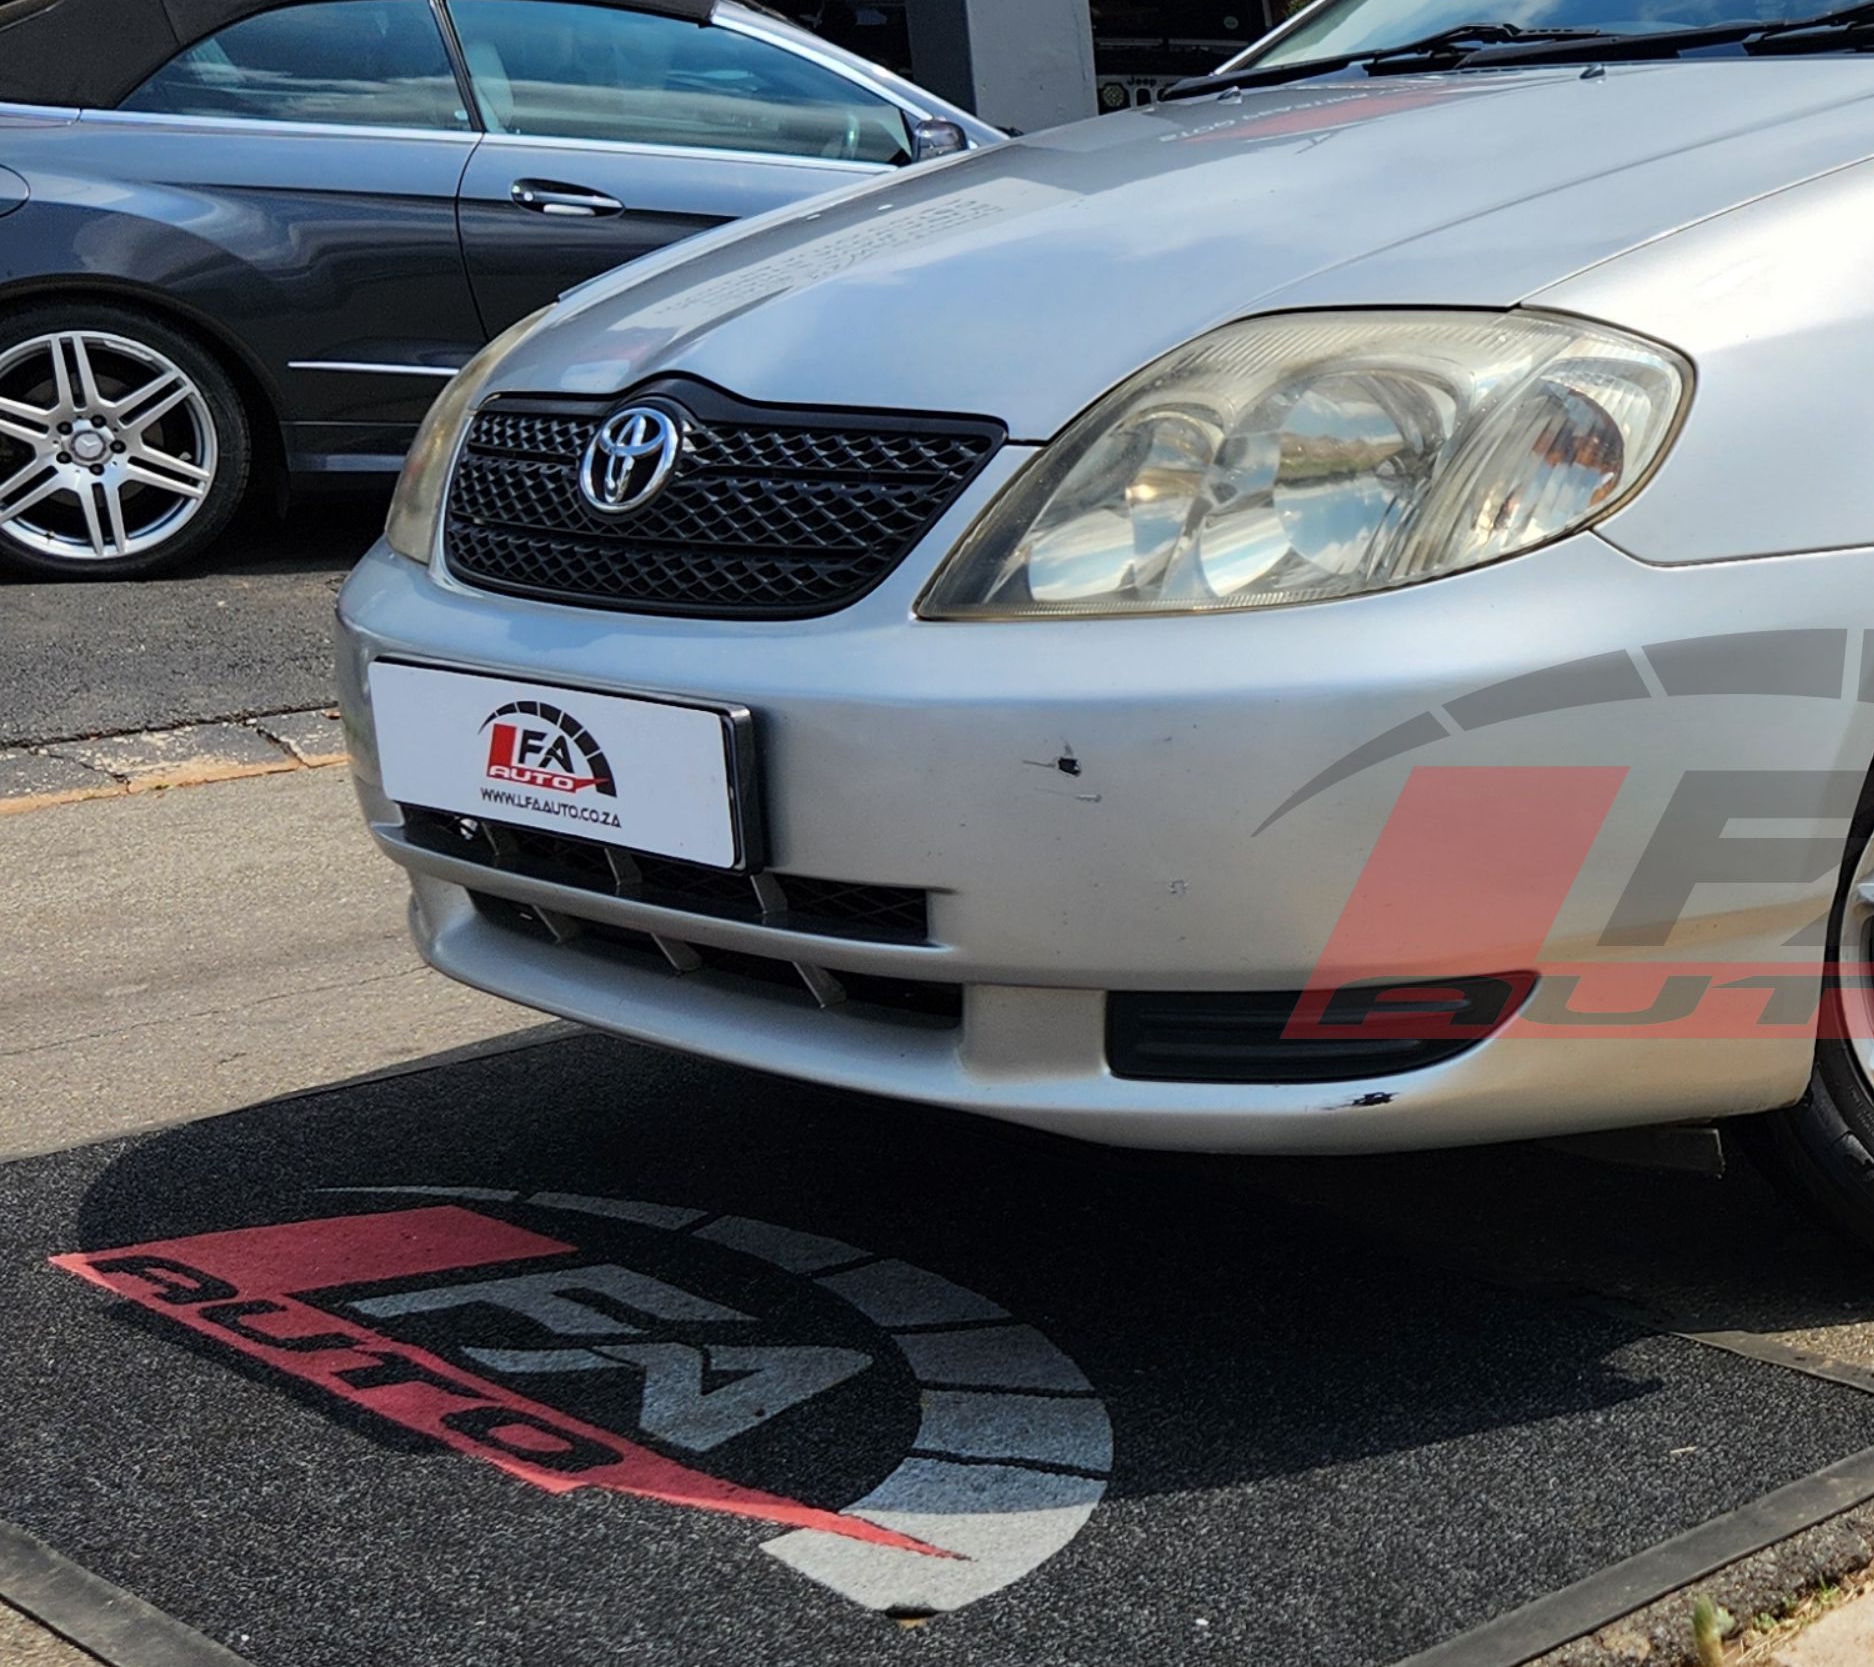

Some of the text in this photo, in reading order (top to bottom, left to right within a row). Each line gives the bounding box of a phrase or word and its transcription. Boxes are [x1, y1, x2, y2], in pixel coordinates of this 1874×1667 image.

[488, 723, 576, 774] LFA
[489, 765, 574, 792] AUTO
[480, 787, 622, 829] WWW.LFAAUTO.CO.ZA
[91, 1253, 622, 1474] AUTO
